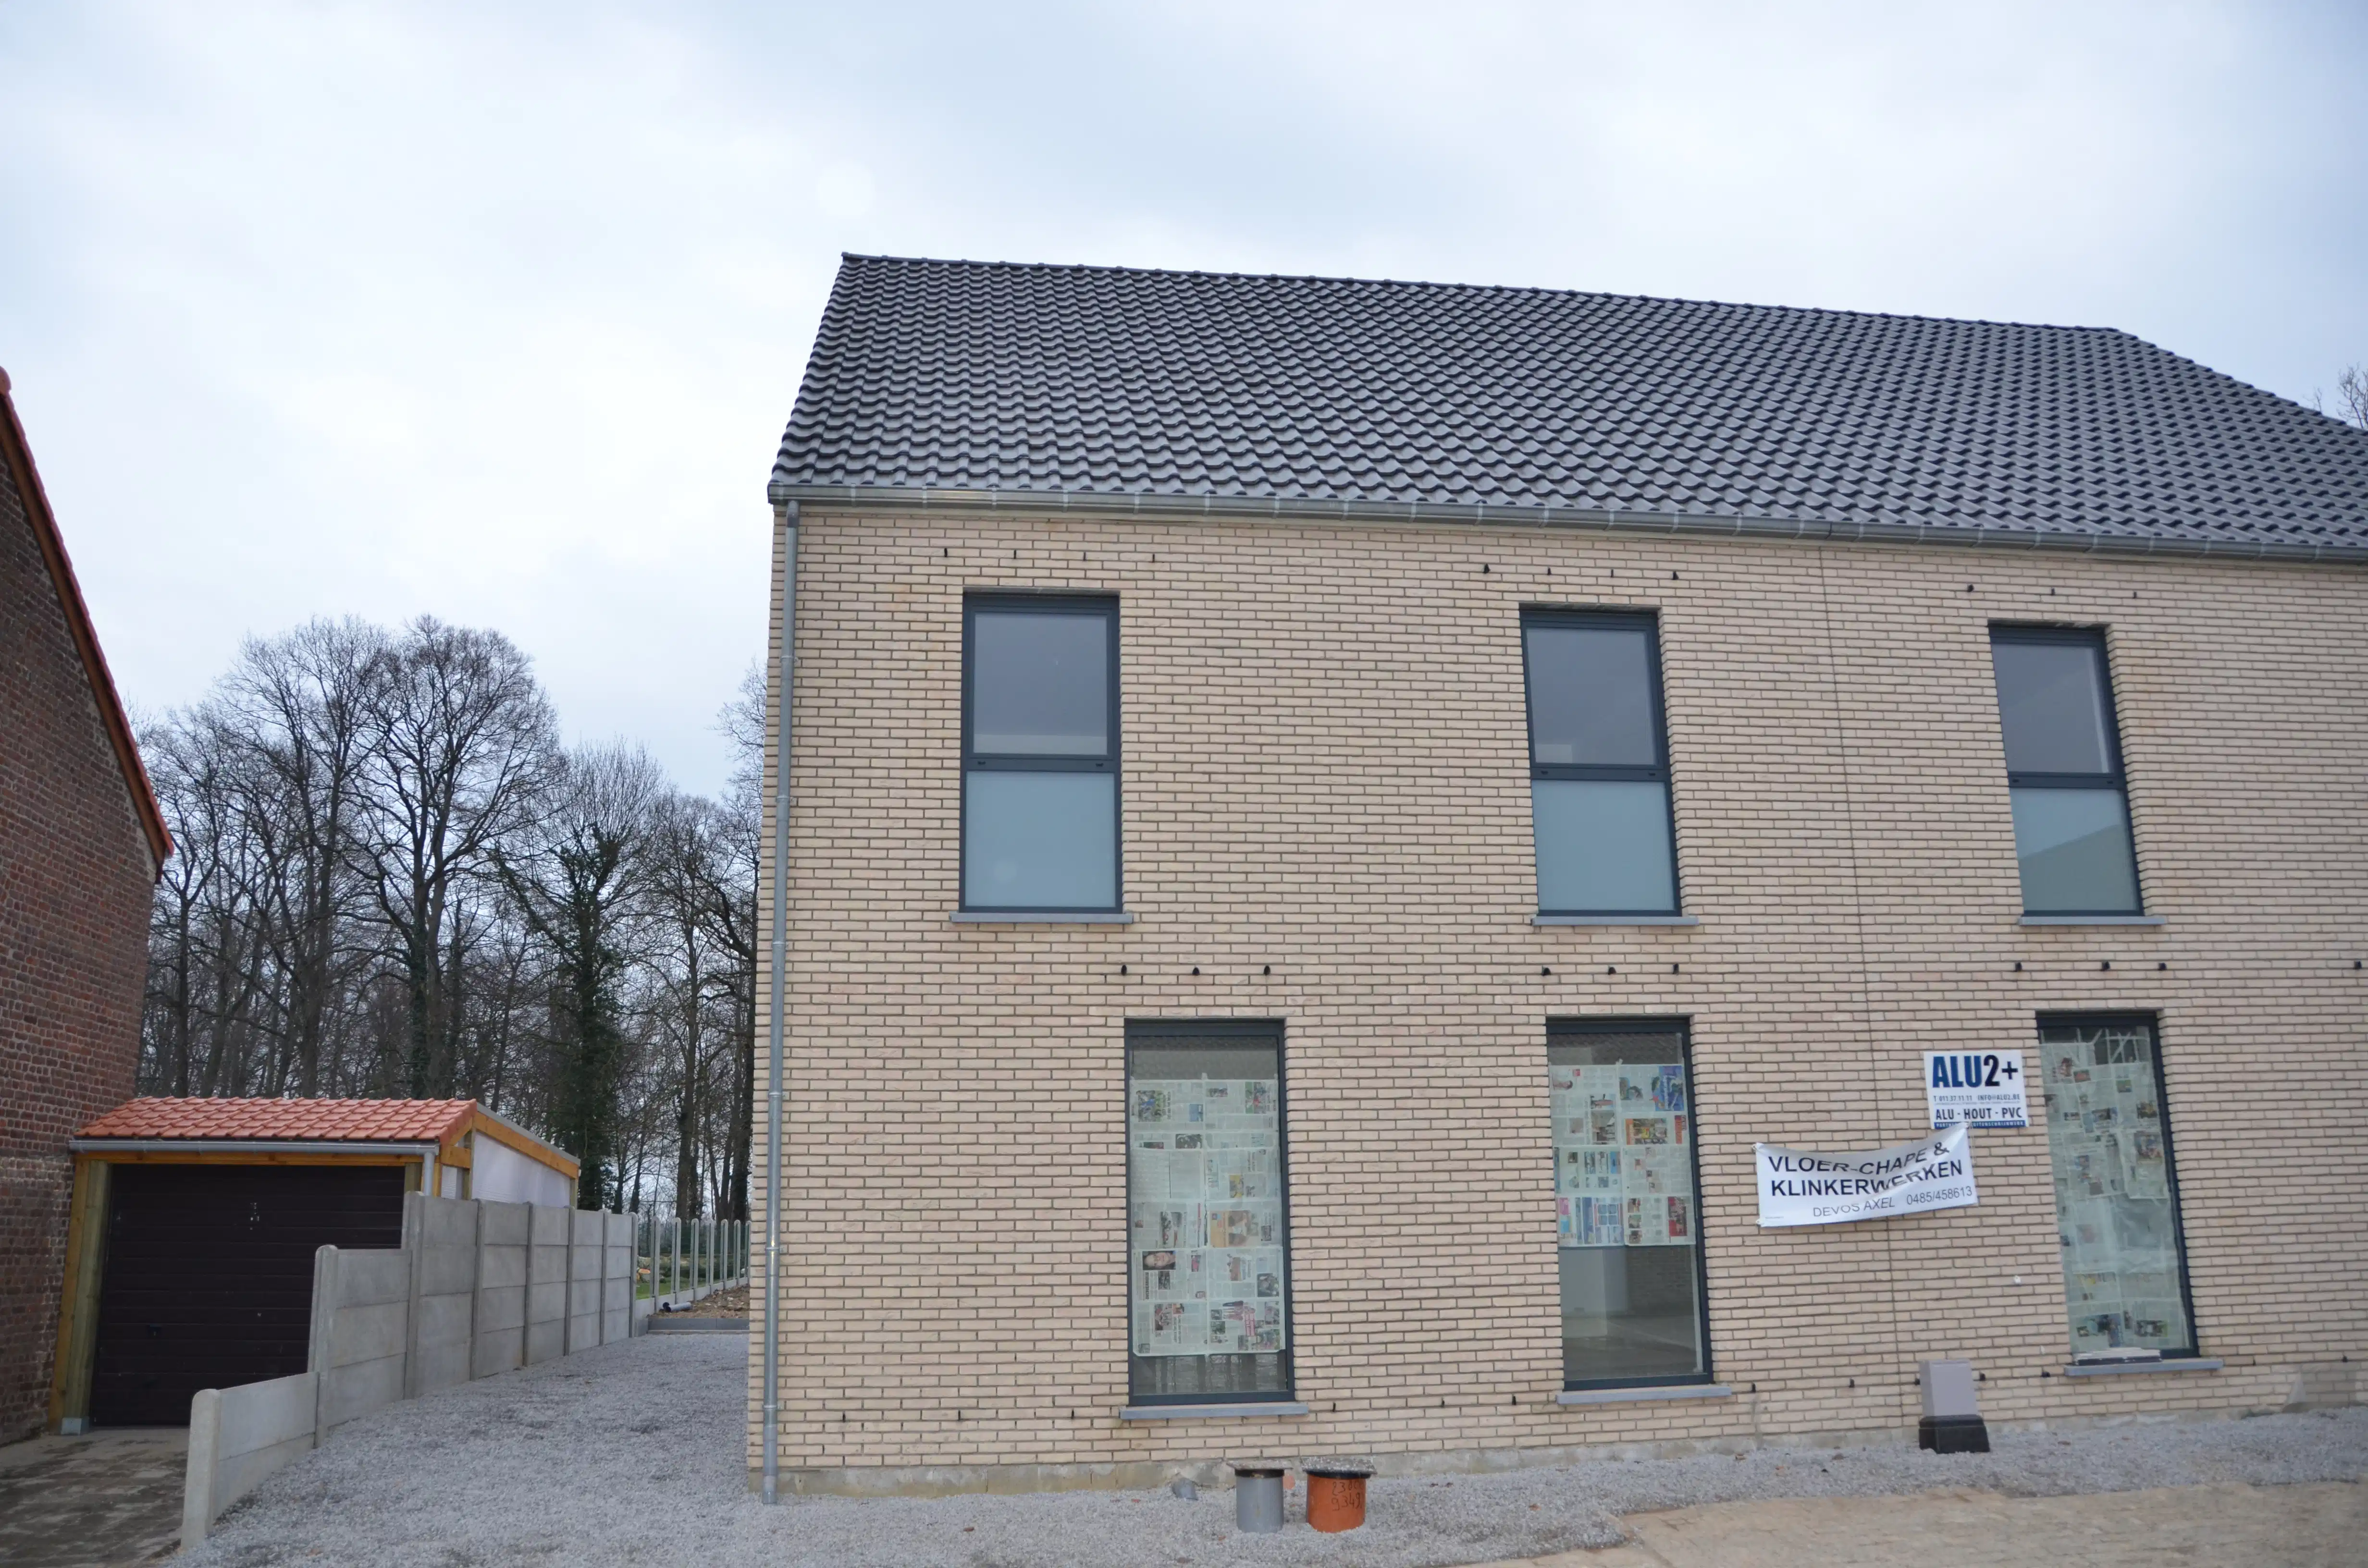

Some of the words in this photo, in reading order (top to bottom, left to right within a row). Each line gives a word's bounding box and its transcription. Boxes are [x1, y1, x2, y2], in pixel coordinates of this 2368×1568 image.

[1933, 1054, 2018, 1088] ALU2+
[1936, 1109, 1954, 1120] ALU
[1963, 1108, 1992, 1119] HOUT
[2002, 1107, 2023, 1118] PVC
[1768, 1148, 1927, 1175] VLOER-CHAPE
[1934, 1141, 1949, 1155] &
[1772, 1159, 1962, 1197] KLINKERWERKEN
[1813, 1204, 1860, 1217] DEVOS
[1864, 1197, 1895, 1211] AXEL
[1907, 1186, 1973, 1205] 0485/458613
